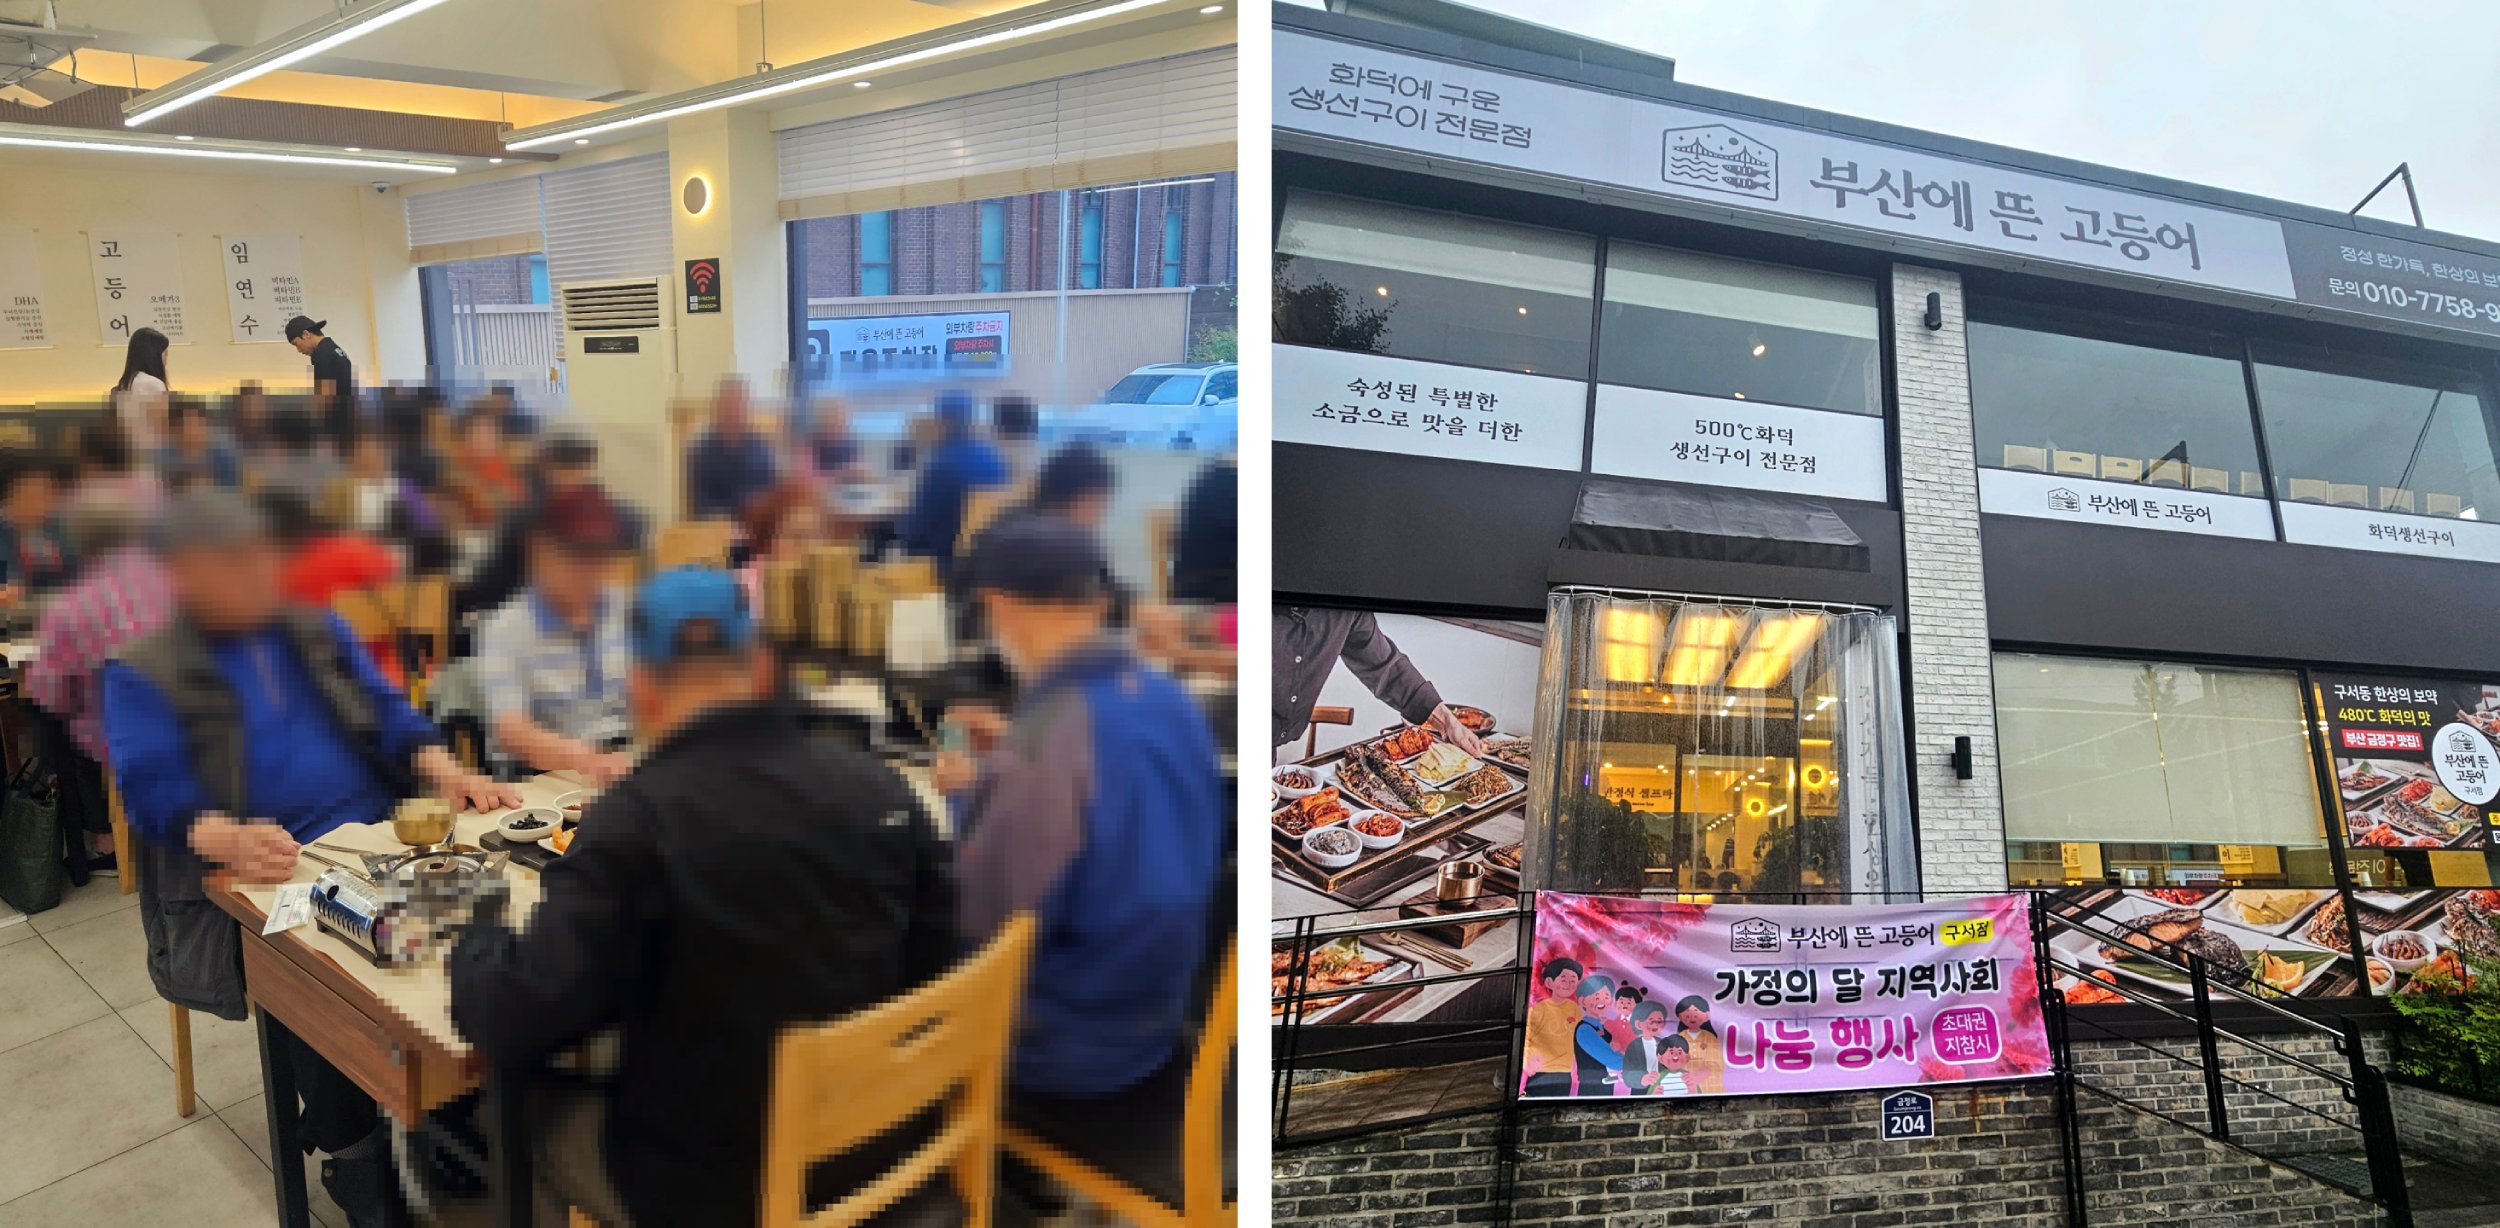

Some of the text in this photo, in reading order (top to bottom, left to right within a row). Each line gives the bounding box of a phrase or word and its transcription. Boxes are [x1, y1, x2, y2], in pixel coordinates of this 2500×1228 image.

[1328, 61, 1501, 114] 화덕에 구운
[1288, 84, 1532, 149] 생선구이 전문점
[1809, 156, 2202, 271] 부산에 뜬 고등어
[2340, 245, 2500, 288] 정성 한가득, 한상의 보
[14, 296, 39, 305] DHA
[231, 241, 259, 336] 임연수
[2328, 277, 2500, 323] 문의 010-7758-9
[873, 328, 894, 341] 부산에
[904, 326, 924, 339] 고등어
[1346, 377, 1499, 413] 숙성된 특별한
[1312, 401, 1523, 443] 소금으로 맛을 더한
[1669, 440, 1817, 475] 생선구이 전문점
[2088, 493, 2212, 525] 부산에 뜬 고등어
[2368, 523, 2455, 548] 화덕생선구이
[2334, 684, 2438, 705] 구서동 한상의 보약
[2379, 709, 2416, 726] 화덕의
[2418, 711, 2431, 727] 맛
[2345, 731, 2420, 748] 부산 금정구 맛집!
[2444, 753, 2489, 769] 부산에 뜬
[2456, 769, 2486, 784] 고등어
[2464, 785, 2484, 796] 구서점
[1787, 921, 1991, 950] 부산에 뜬 고등어 구서점
[1714, 957, 2000, 1006] 가정의 달 지역사회
[1940, 1012, 1988, 1033] 초대권
[1725, 1015, 1919, 1070] 나눔 행사
[1944, 1034, 1993, 1056] 지참시
[1897, 1096, 1917, 1107] 금정로
[1891, 1115, 1926, 1134] 204
